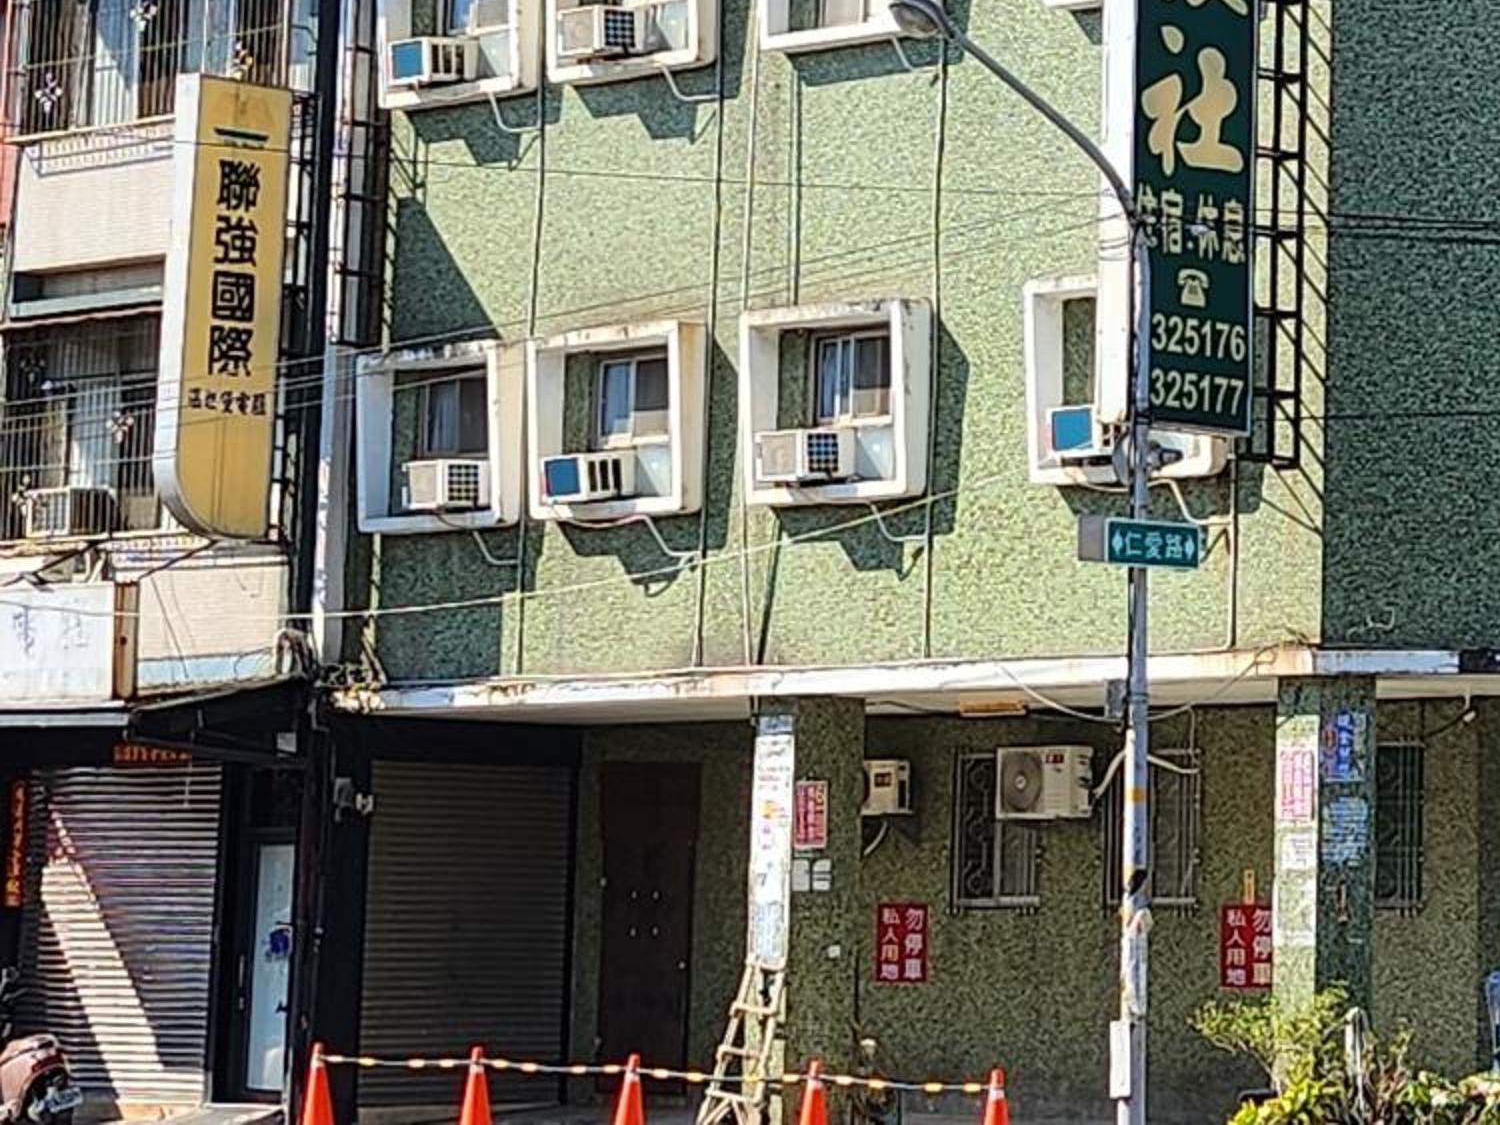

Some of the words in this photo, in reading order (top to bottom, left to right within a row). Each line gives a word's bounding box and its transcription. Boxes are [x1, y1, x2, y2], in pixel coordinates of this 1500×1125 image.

[207, 159, 261, 377] 聯強國際
[880, 907, 901, 980] 私人用地
[904, 906, 925, 981] 勿停車
[1225, 908, 1248, 986] 私人用地
[1251, 907, 1272, 985] 勿停車
